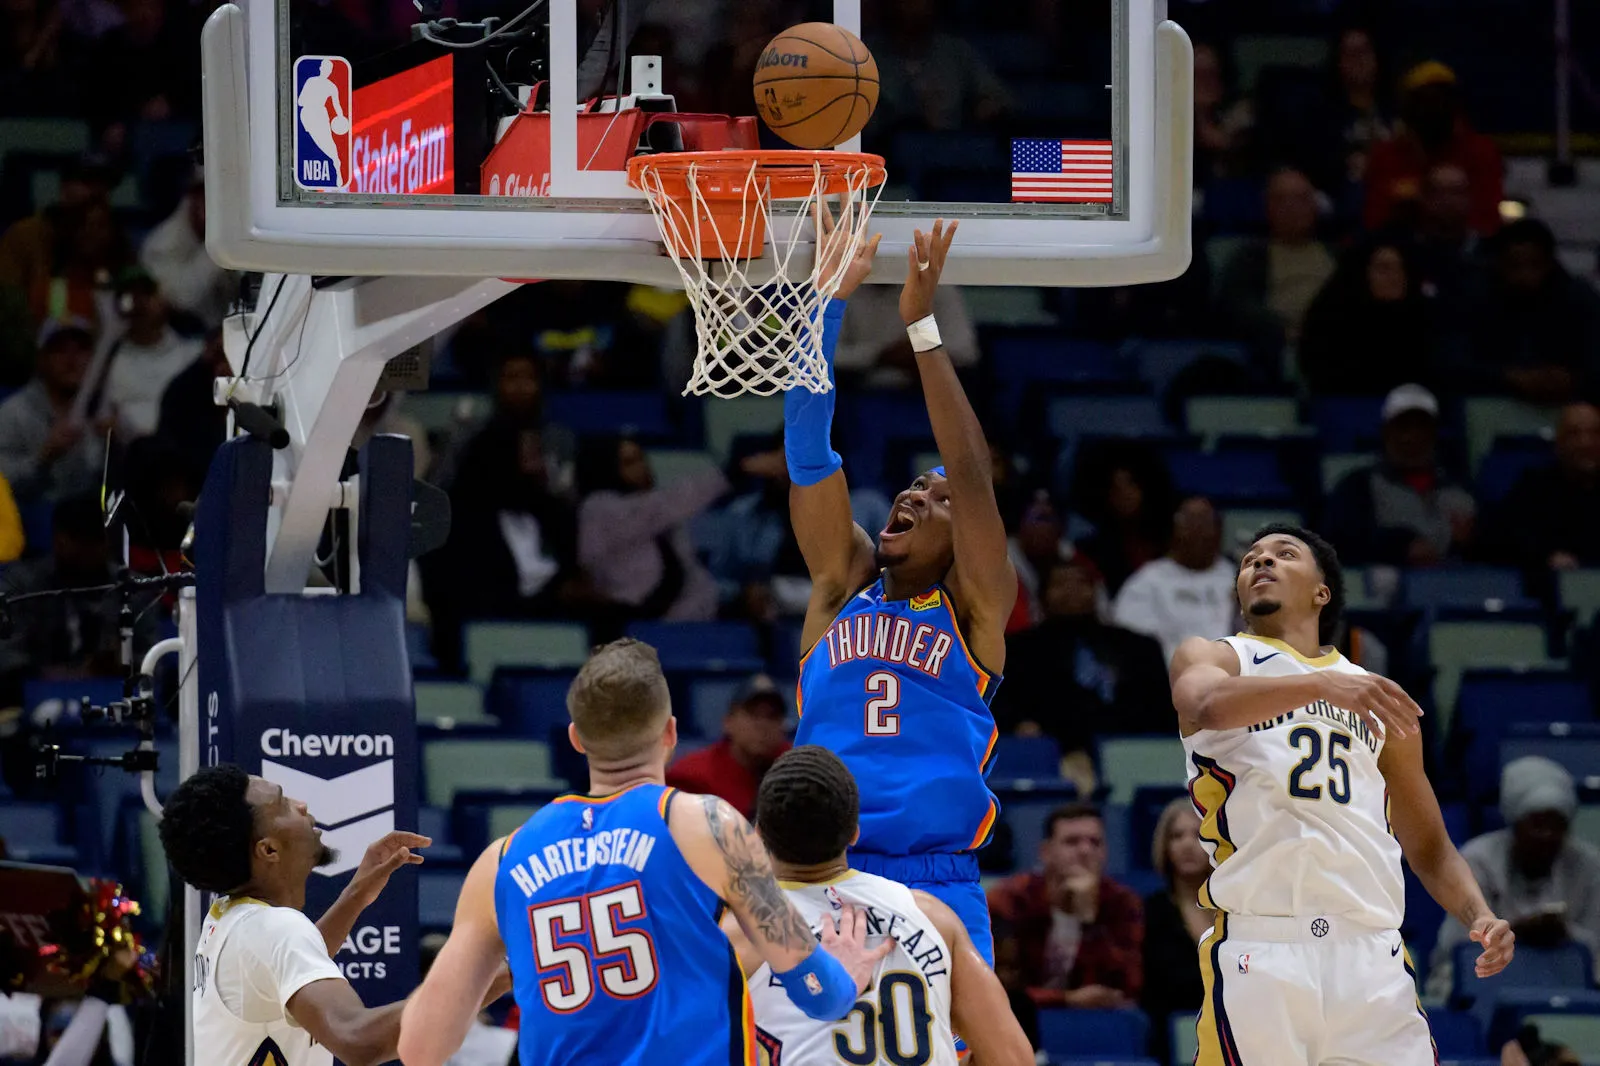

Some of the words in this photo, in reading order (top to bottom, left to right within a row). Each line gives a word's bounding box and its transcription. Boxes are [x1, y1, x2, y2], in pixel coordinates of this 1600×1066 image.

[755, 46, 808, 72] ilson
[303, 159, 331, 181] NBA
[826, 613, 952, 679] THUNDER
[865, 670, 900, 736] 2
[260, 728, 394, 756] Chevron
[1288, 725, 1352, 804] 25
[510, 828, 656, 898] HARTENSTEIN
[527, 880, 660, 1015] 55
[832, 970, 935, 1066] 50
